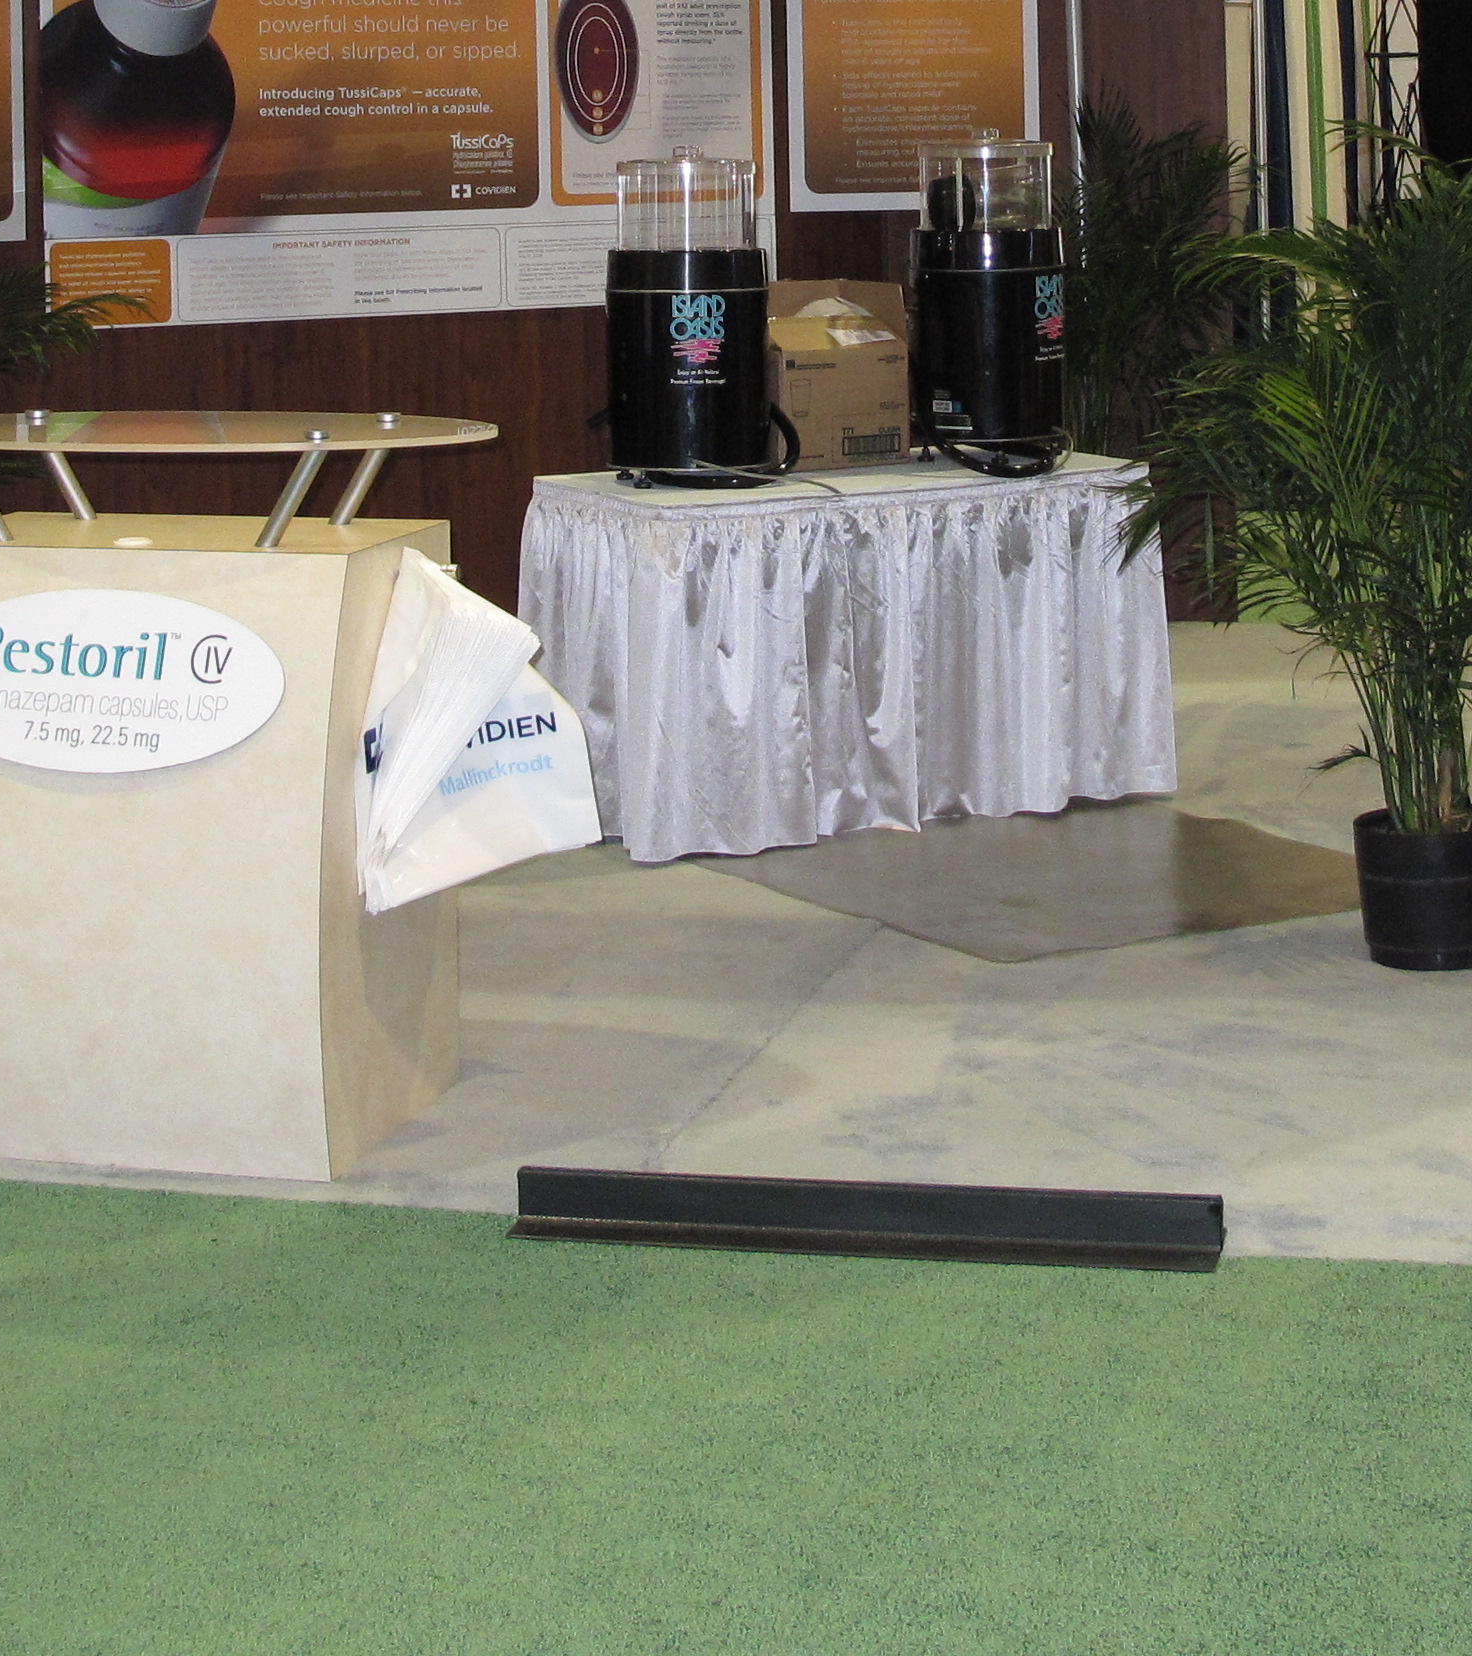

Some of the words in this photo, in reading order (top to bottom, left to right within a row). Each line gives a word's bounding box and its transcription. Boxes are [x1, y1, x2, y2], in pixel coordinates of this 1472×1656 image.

[258, 14, 346, 35] powerful
[354, 14, 419, 33] should
[426, 17, 479, 33] never
[485, 15, 509, 33] be
[259, 43, 334, 62] sucked,
[341, 42, 420, 62] slurped,
[426, 45, 446, 59] or
[453, 42, 522, 62] sipped.
[259, 87, 335, 101] Introducing
[259, 104, 320, 117] extended
[324, 104, 364, 119] cough
[368, 103, 413, 115] control
[417, 103, 428, 114] in
[432, 105, 439, 113] a
[442, 102, 493, 116] capsule.
[475, 185, 516, 195] COVIDIEN
[272, 241, 320, 249] IMPORTANT
[322, 239, 351, 248] SAFETY
[353, 237, 410, 247] INFORMATION
[671, 294, 726, 318] ISLAND
[669, 316, 725, 340] OASIS
[185, 693, 229, 723] USP
[23, 721, 50, 741] 7.5
[54, 726, 84, 748] mg,
[91, 724, 129, 746] 22.5
[133, 729, 161, 753] mg
[438, 753, 555, 797] Mallinckrodt
